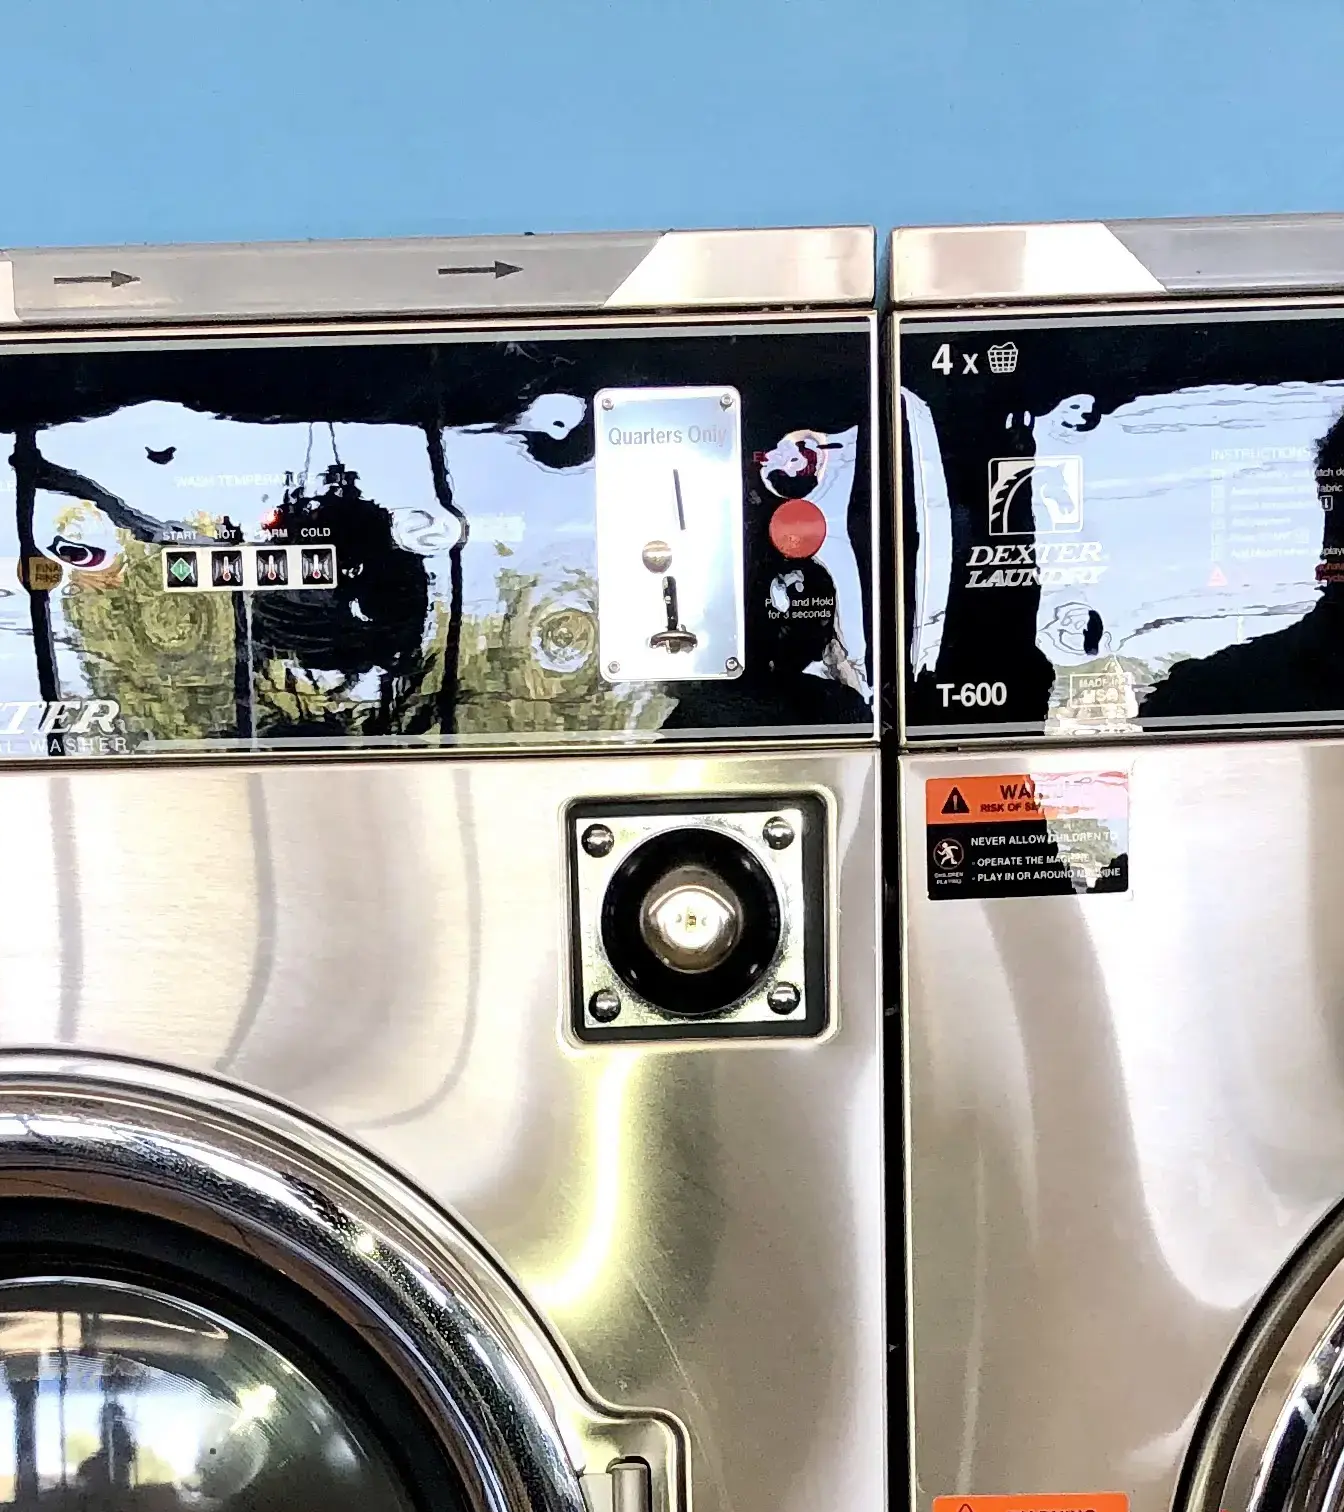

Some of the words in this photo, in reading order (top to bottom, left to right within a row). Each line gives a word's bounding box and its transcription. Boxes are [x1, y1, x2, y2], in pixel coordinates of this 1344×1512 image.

[932, 344, 953, 375] 4
[962, 354, 979, 374] x
[608, 427, 683, 445] Quarters
[688, 425, 727, 448] Only
[163, 531, 196, 540] START
[214, 529, 236, 540] HOT
[300, 527, 331, 538] COLD
[966, 541, 1103, 566] DEXTER
[965, 566, 1109, 588] LAUNDRY
[792, 597, 810, 607] and
[812, 596, 834, 606] Hold
[768, 609, 781, 619] for
[792, 608, 831, 618] seconds
[936, 682, 1007, 707] T-600
[30, 738, 130, 753] WASHER
[980, 803, 1004, 812] RISK
[1007, 803, 1022, 812] OF
[971, 837, 1006, 846] NEVER
[1008, 835, 1046, 845] ALLOW
[1047, 832, 1101, 844] CHILDREN
[977, 857, 1023, 867] OPERATE
[1025, 856, 1044, 866] THE
[977, 872, 1002, 882] PLAY
[1005, 872, 1015, 881] IN
[1017, 871, 1031, 881] OR
[1033, 869, 1074, 880] AROUND
